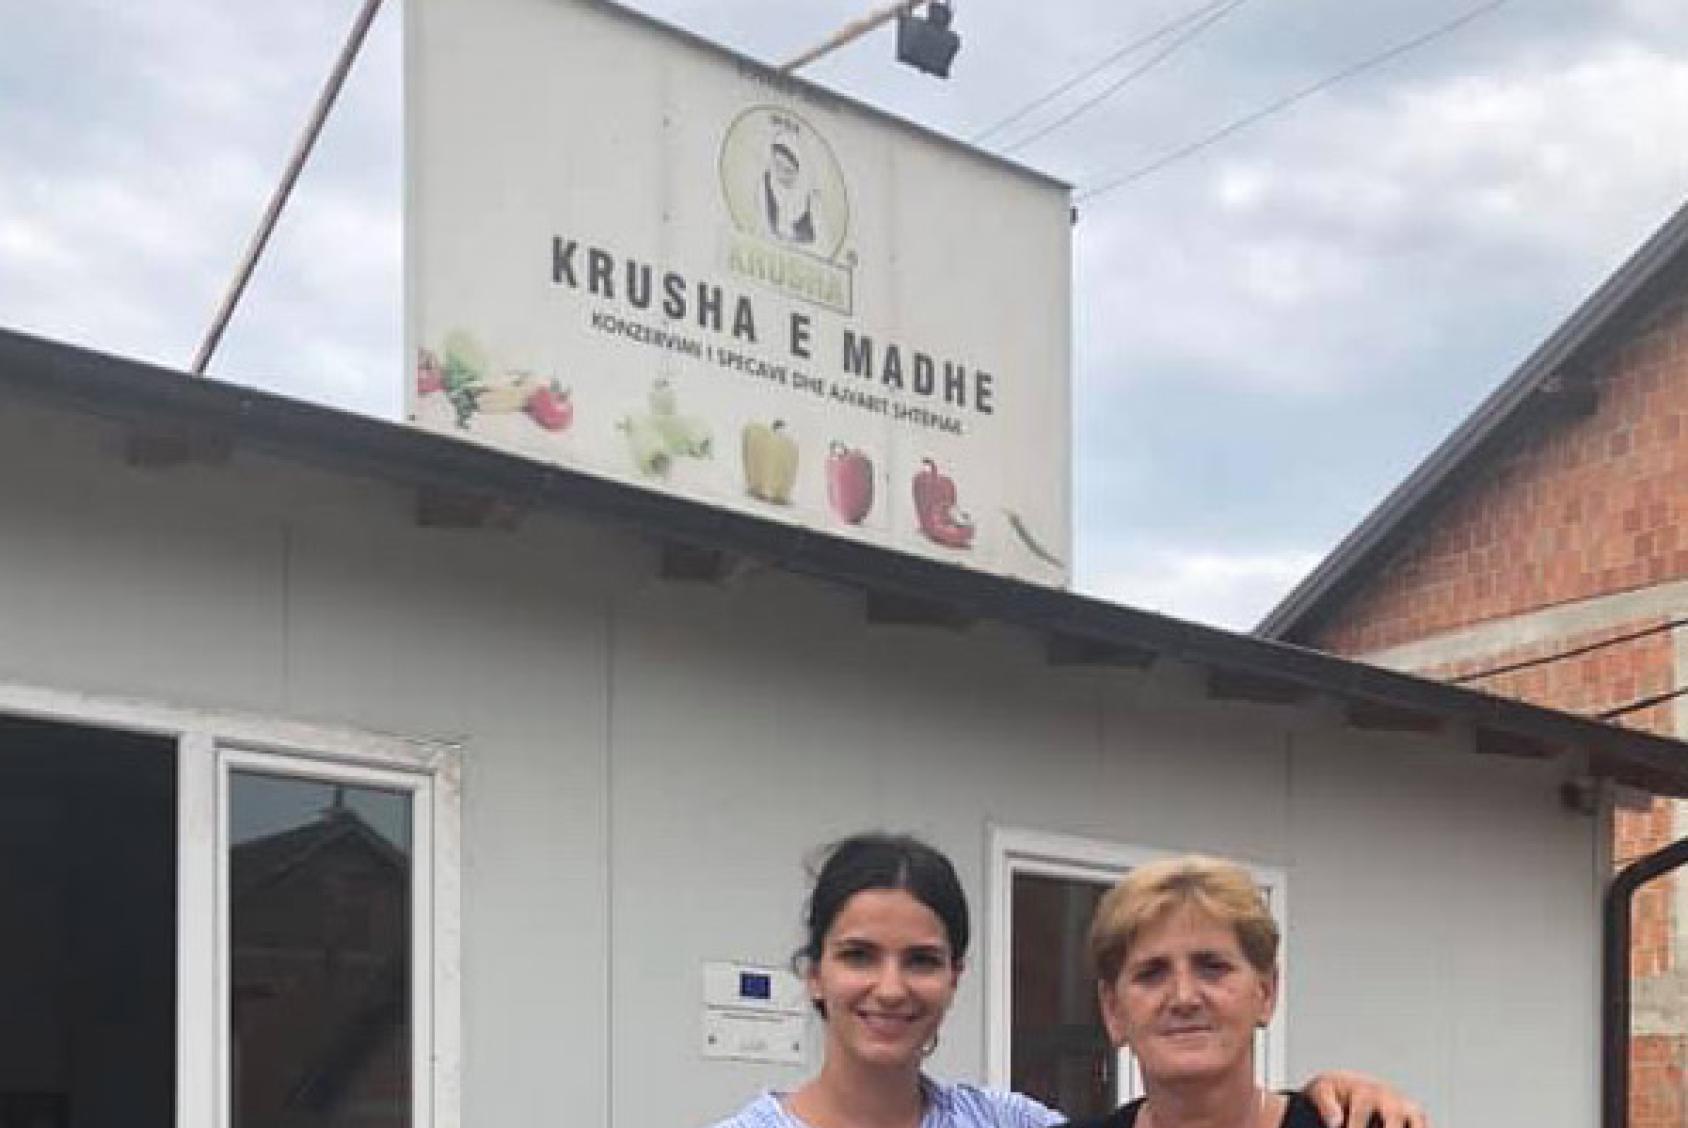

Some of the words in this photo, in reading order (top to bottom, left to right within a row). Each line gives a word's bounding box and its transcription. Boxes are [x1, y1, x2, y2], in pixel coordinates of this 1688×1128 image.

[552, 235, 757, 342] KRUSHA
[790, 312, 811, 358] E
[843, 329, 994, 415] MADHE
